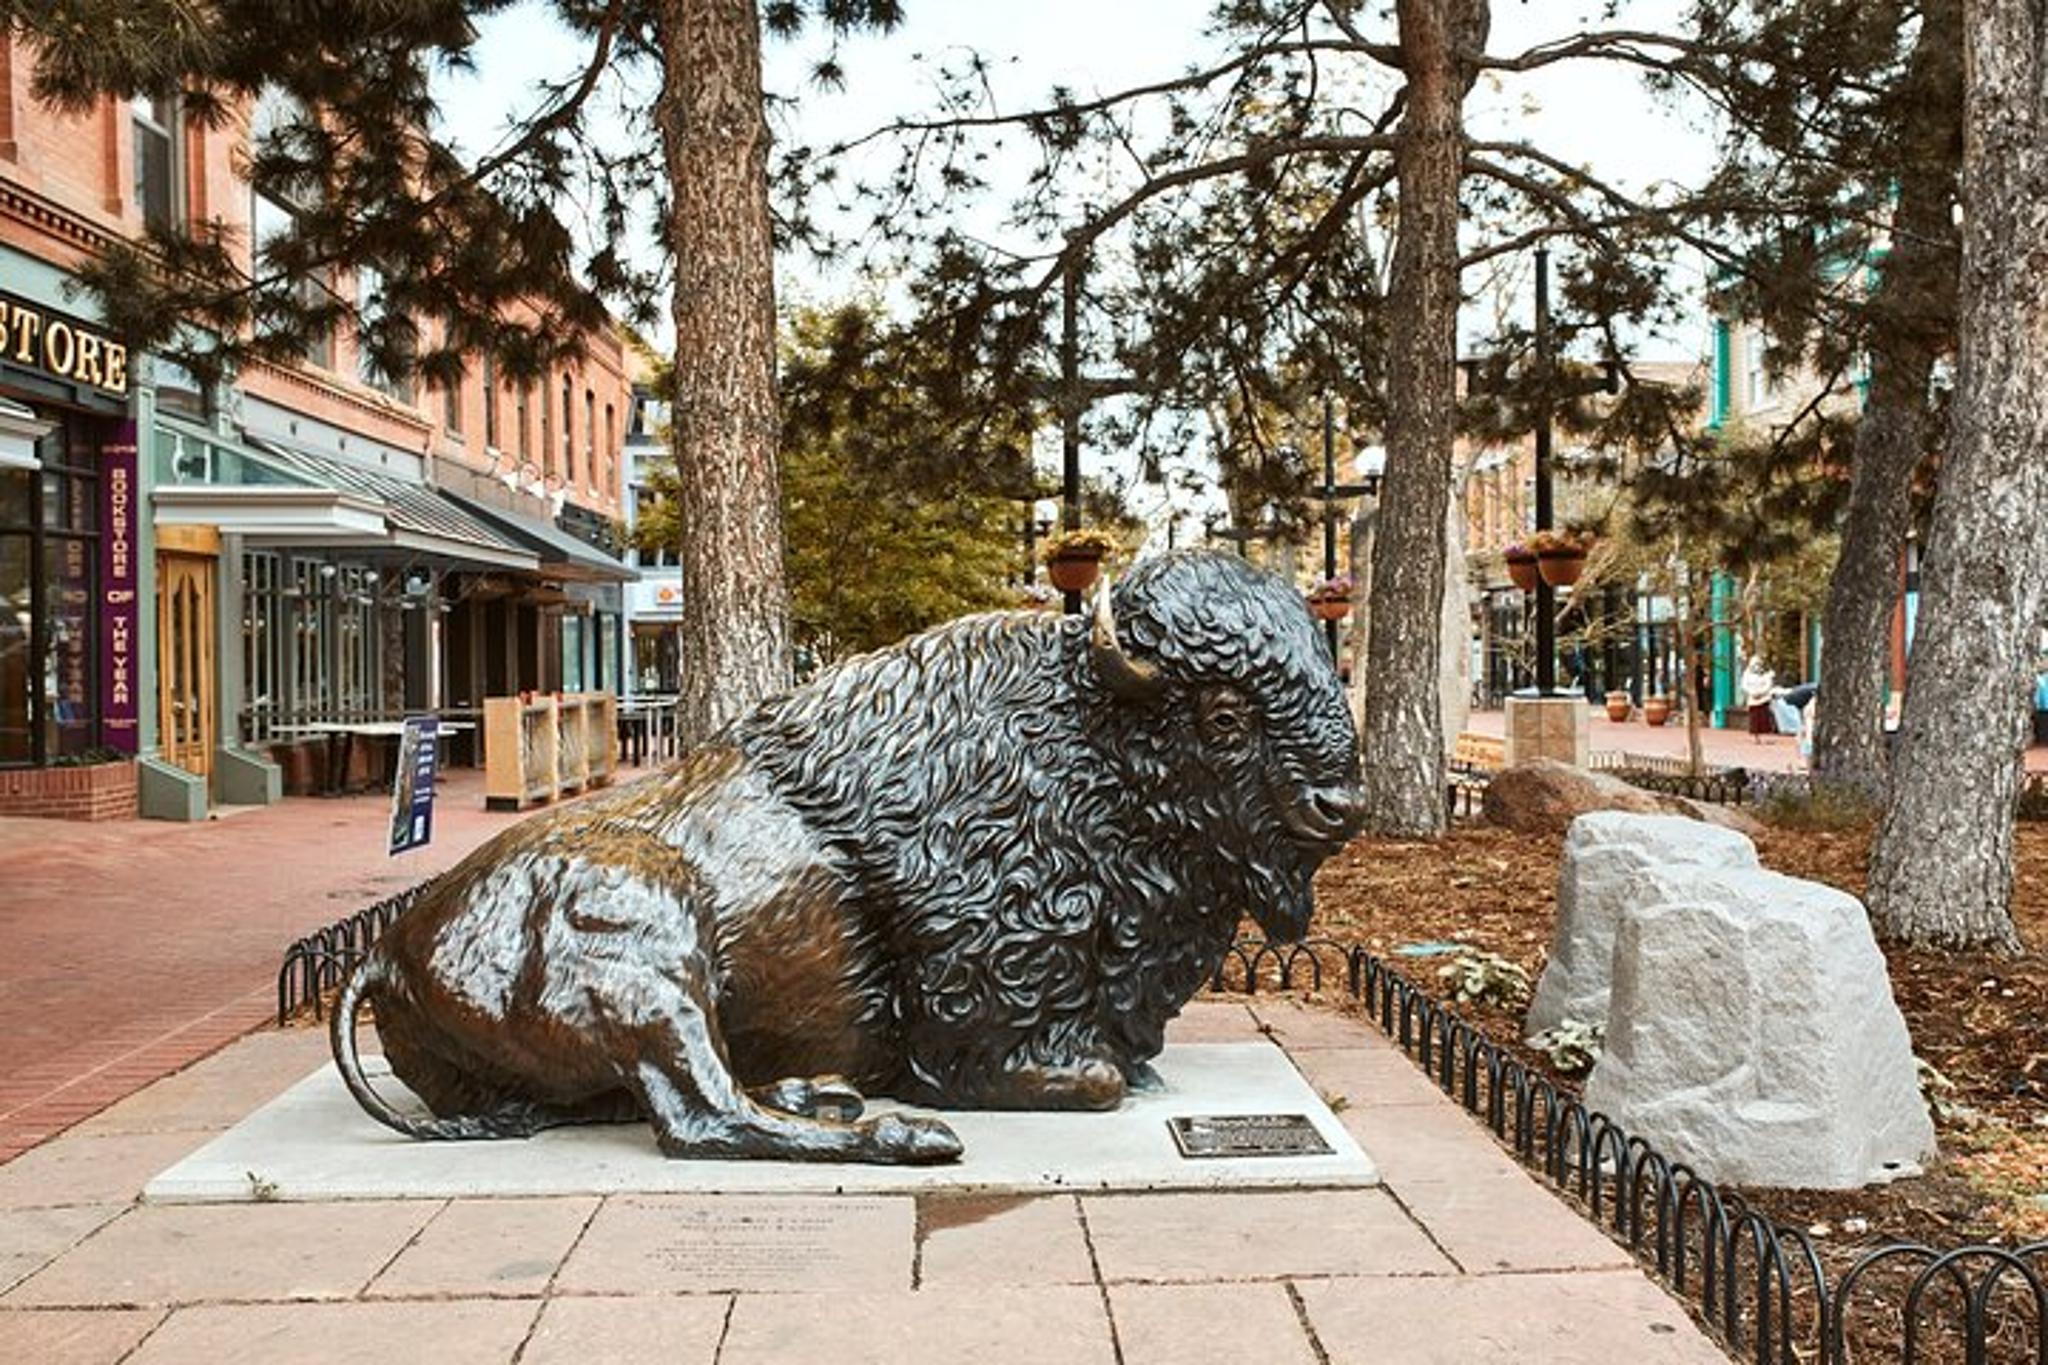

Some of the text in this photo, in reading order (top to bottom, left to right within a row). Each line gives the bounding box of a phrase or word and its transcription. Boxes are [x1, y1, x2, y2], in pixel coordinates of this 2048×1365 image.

[112, 468, 128, 578] BOOKSTORE
[107, 590, 134, 603] OF
[113, 617, 128, 651] THE
[113, 656, 128, 704] YEAR
